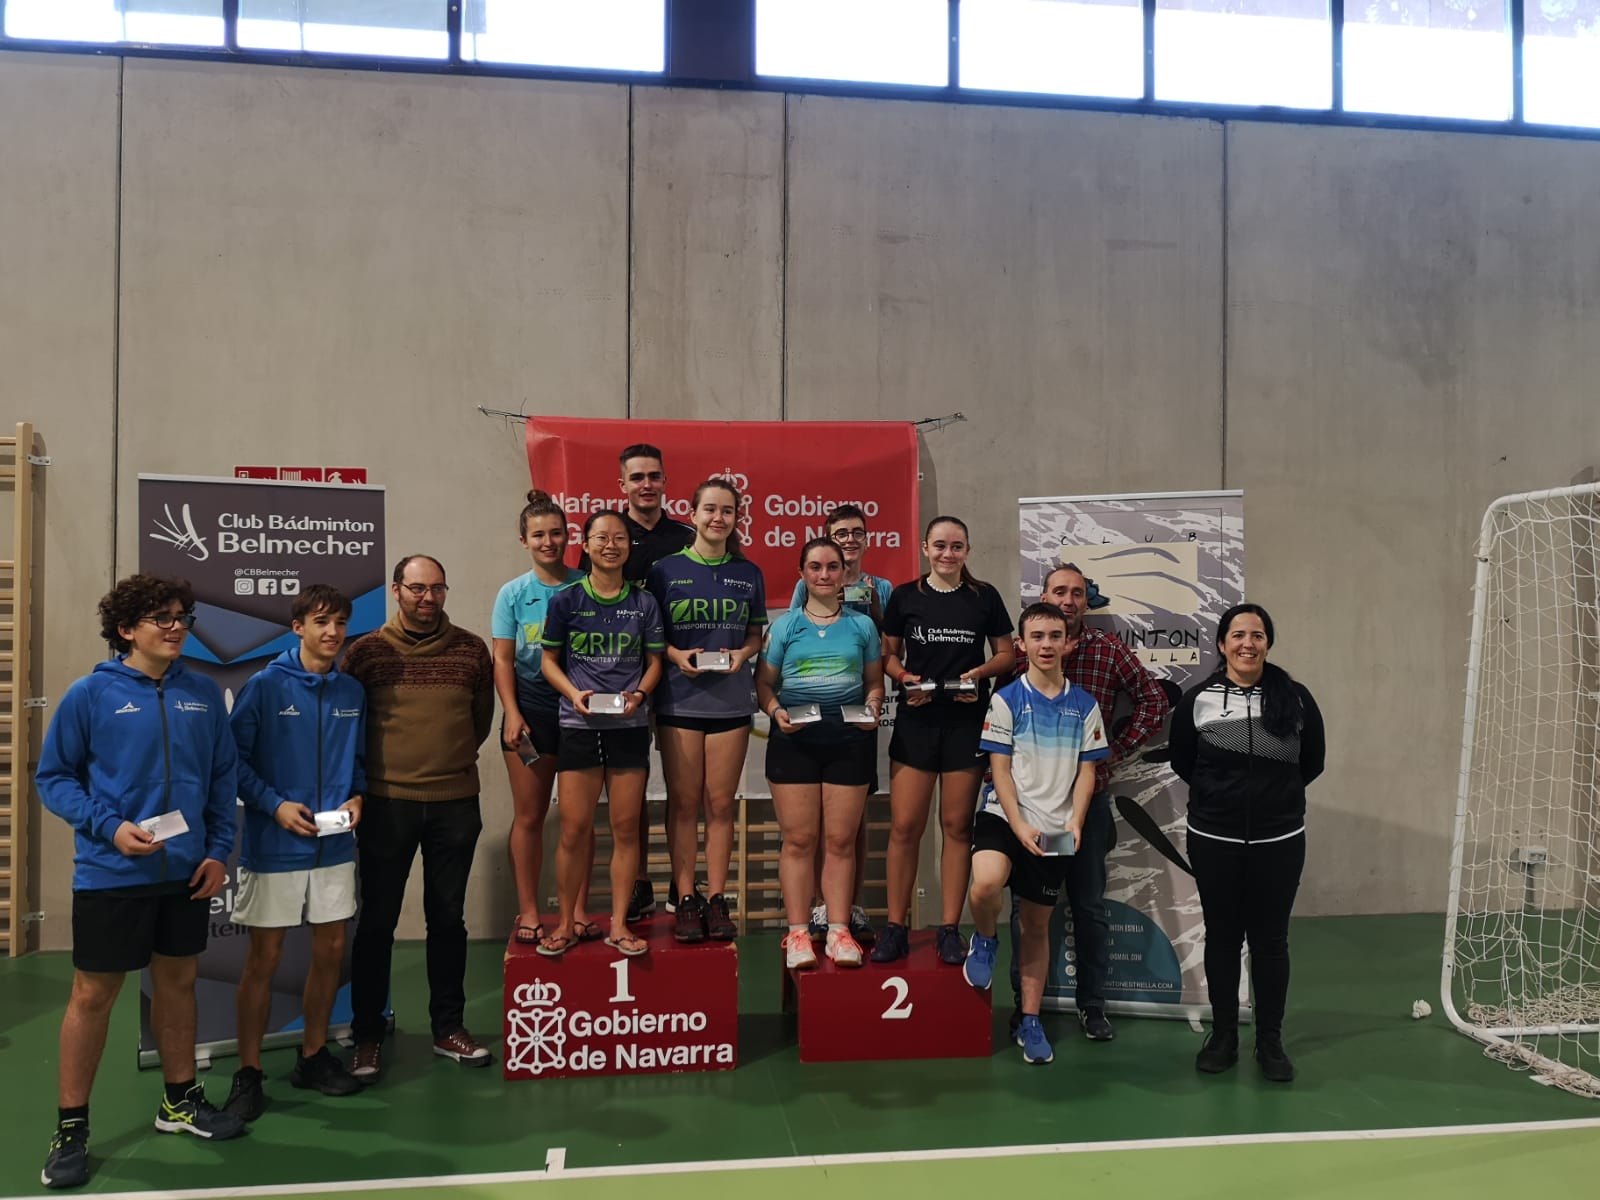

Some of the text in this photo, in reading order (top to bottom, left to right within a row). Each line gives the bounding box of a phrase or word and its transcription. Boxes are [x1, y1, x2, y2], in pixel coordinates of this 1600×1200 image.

[552, 492, 691, 516] Nafarrko
[218, 513, 375, 533] Club Bádminton
[218, 532, 375, 556] Belmecher
[764, 525, 900, 547] de Nrra
[234, 568, 300, 577] @CBBelmecher
[693, 598, 750, 622] RIPA
[590, 632, 641, 655] RIPA
[928, 634, 975, 644] Belmecher
[608, 958, 636, 1003] 1
[881, 976, 913, 1019] 2
[568, 1008, 707, 1037] Gobierno
[568, 1043, 734, 1071] de Navarra
